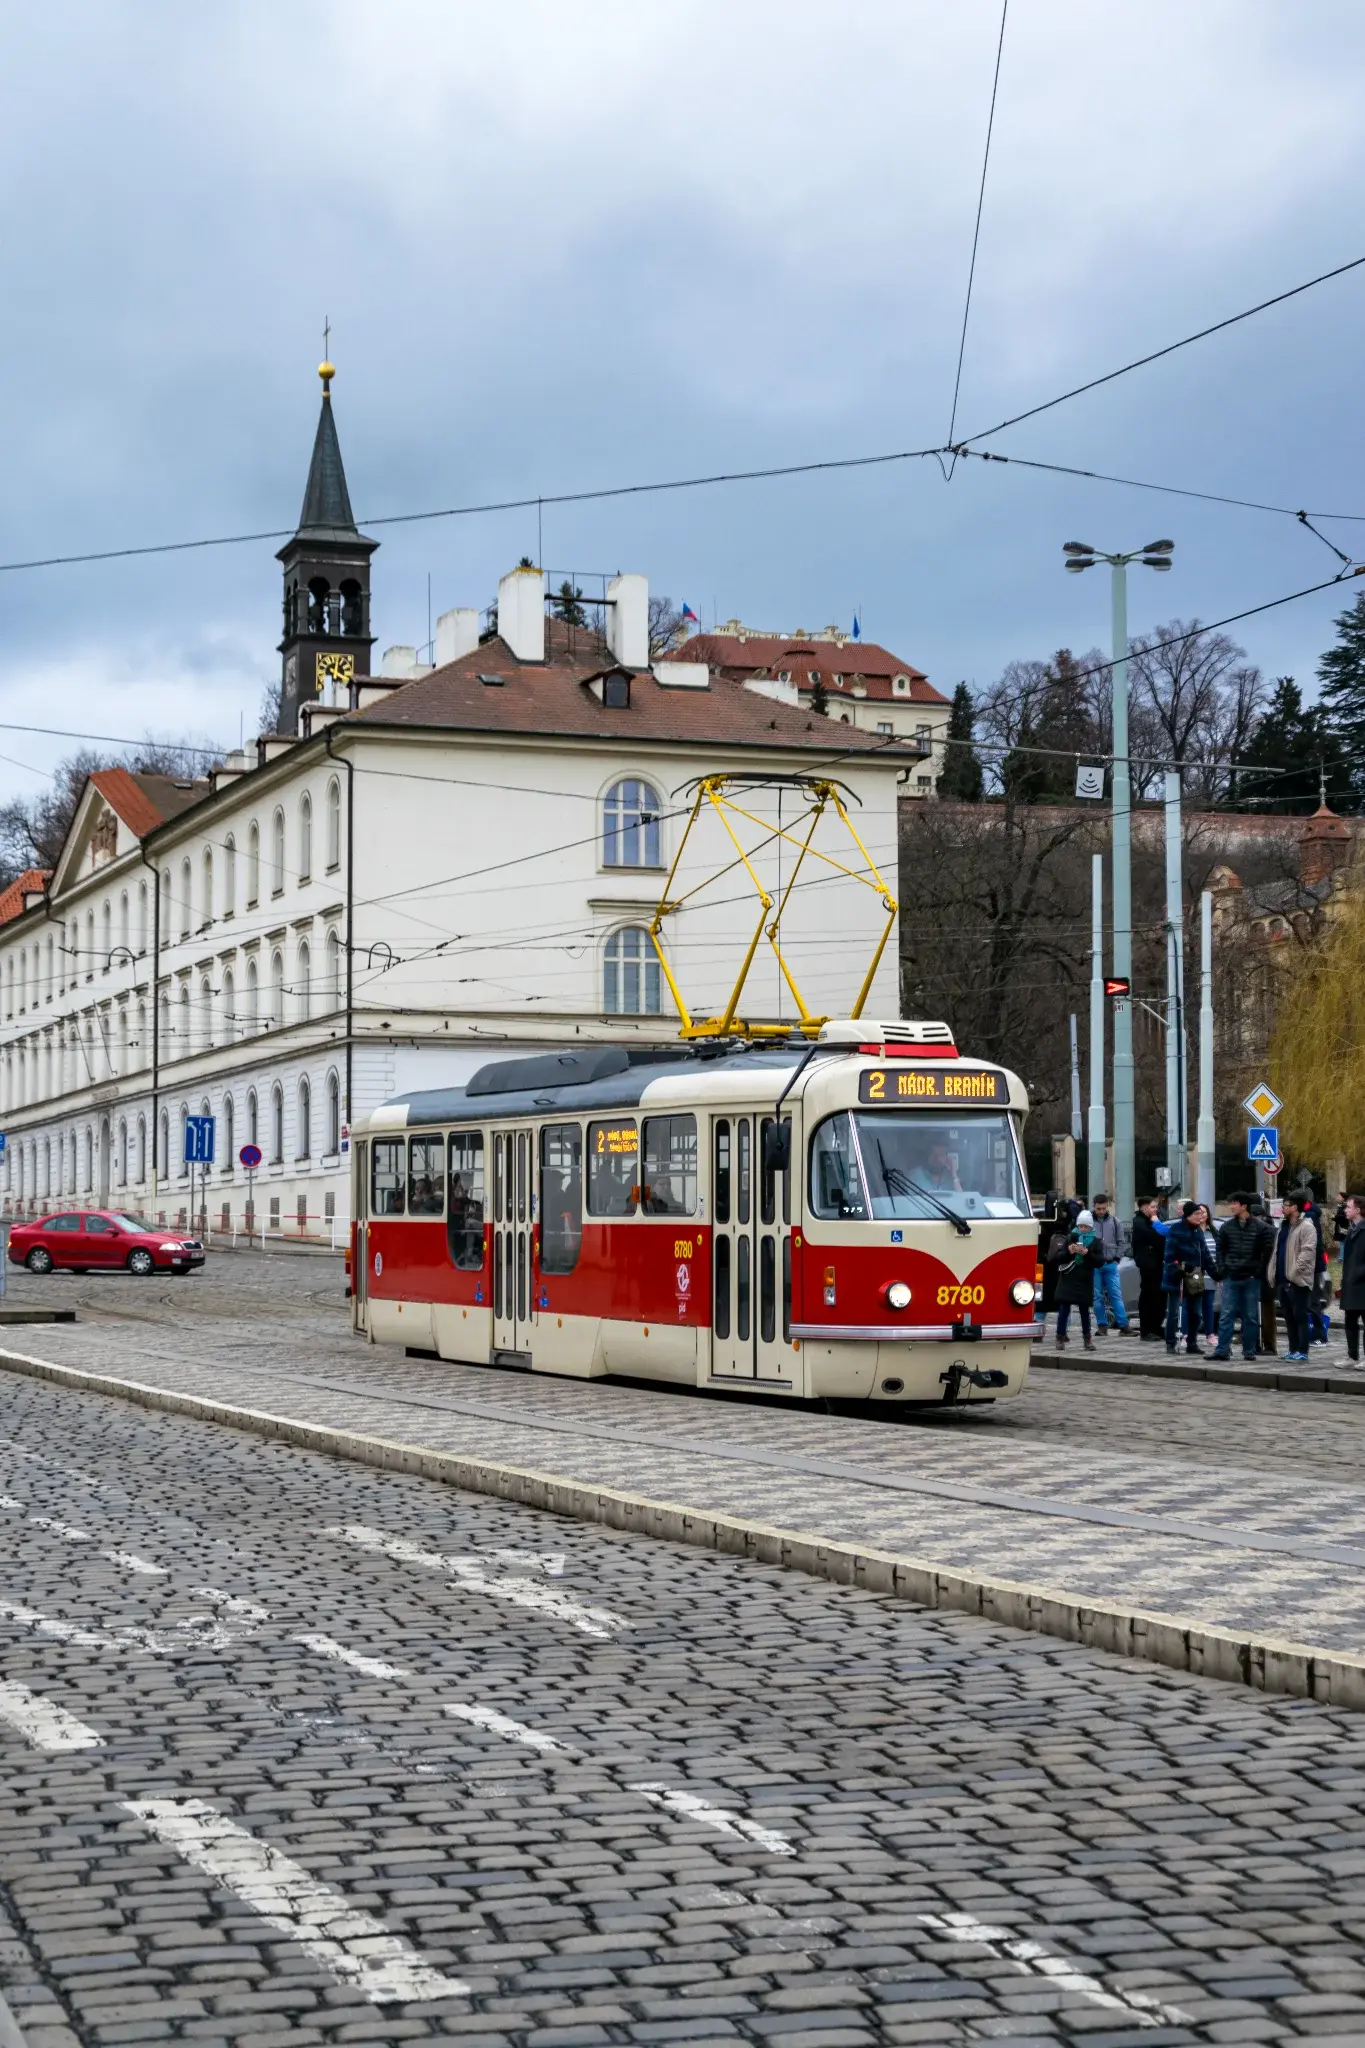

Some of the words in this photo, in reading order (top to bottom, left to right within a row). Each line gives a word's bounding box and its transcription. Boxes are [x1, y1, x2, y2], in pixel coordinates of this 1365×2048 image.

[869, 1071, 886, 1098] 2
[898, 1072, 940, 1095] NÁDR.
[944, 1072, 995, 1097] BRANÍK
[597, 1130, 604, 1153] 2
[674, 1240, 692, 1258] 8780
[936, 1285, 985, 1306] 8780
